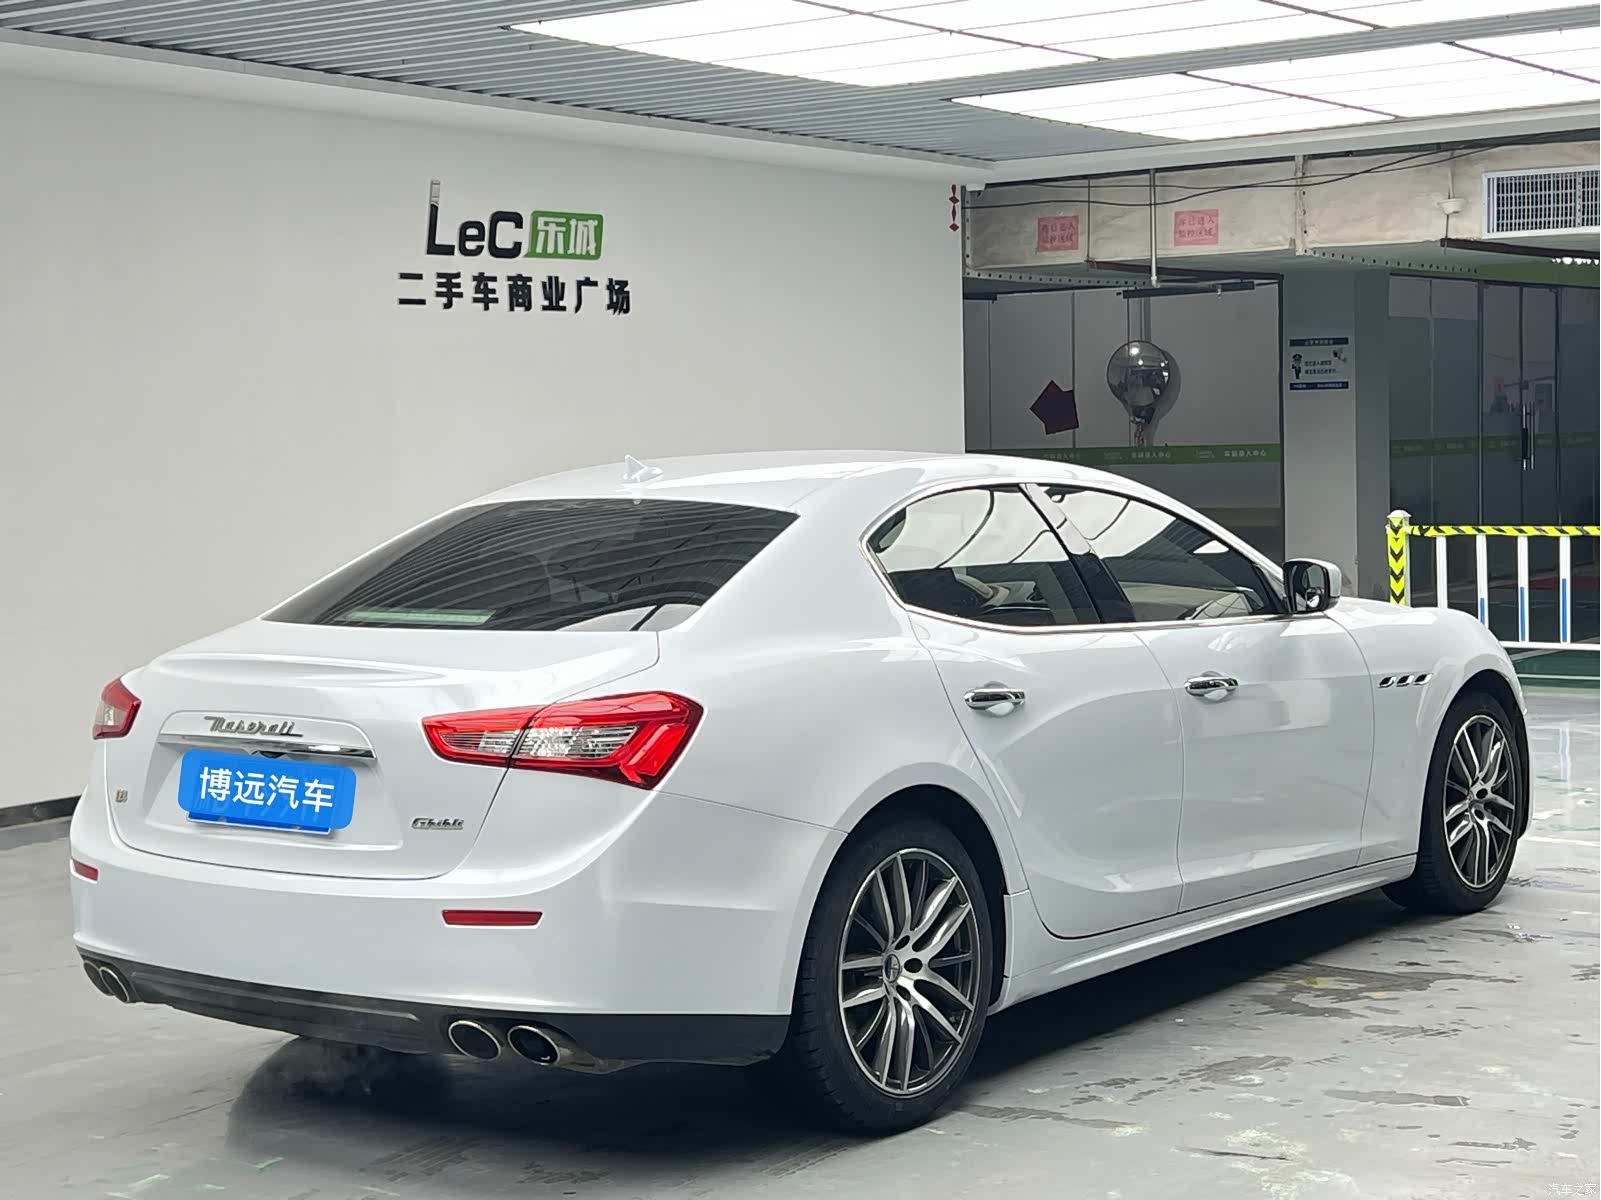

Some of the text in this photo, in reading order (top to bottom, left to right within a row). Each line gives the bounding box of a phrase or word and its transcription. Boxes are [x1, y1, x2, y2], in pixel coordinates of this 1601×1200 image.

[535, 216, 599, 256] 乐城
[398, 271, 631, 316] 二手车商业广场
[204, 716, 304, 738] Maserati
[411, 817, 464, 831] Ghibli
